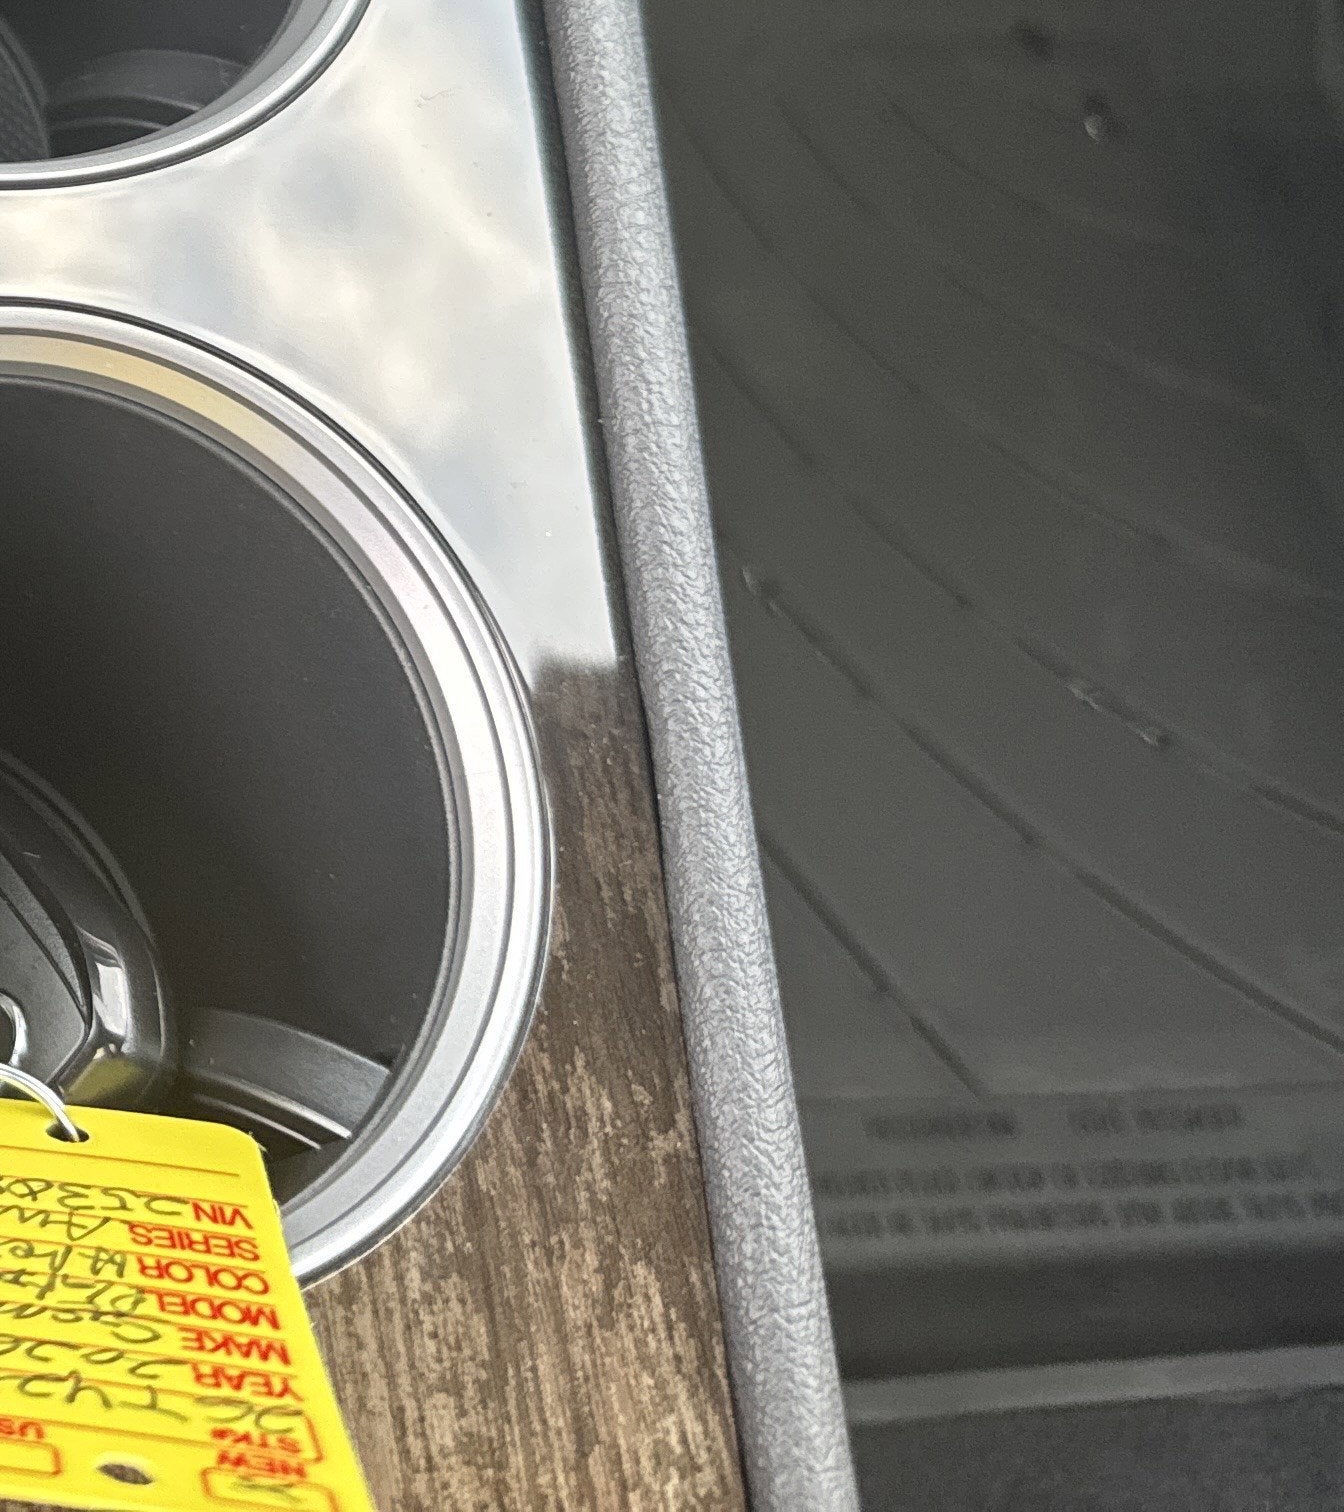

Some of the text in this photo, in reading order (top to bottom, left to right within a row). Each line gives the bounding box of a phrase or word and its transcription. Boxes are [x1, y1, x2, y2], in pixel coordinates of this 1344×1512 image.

[192, 1201, 254, 1230] VIN
[128, 1223, 261, 1262] SERIES
[136, 1256, 271, 1296] COLOR
[144, 1290, 280, 1331] MODEL
[180, 1326, 291, 1367] MAKE
[188, 1361, 304, 1402] YEAR
